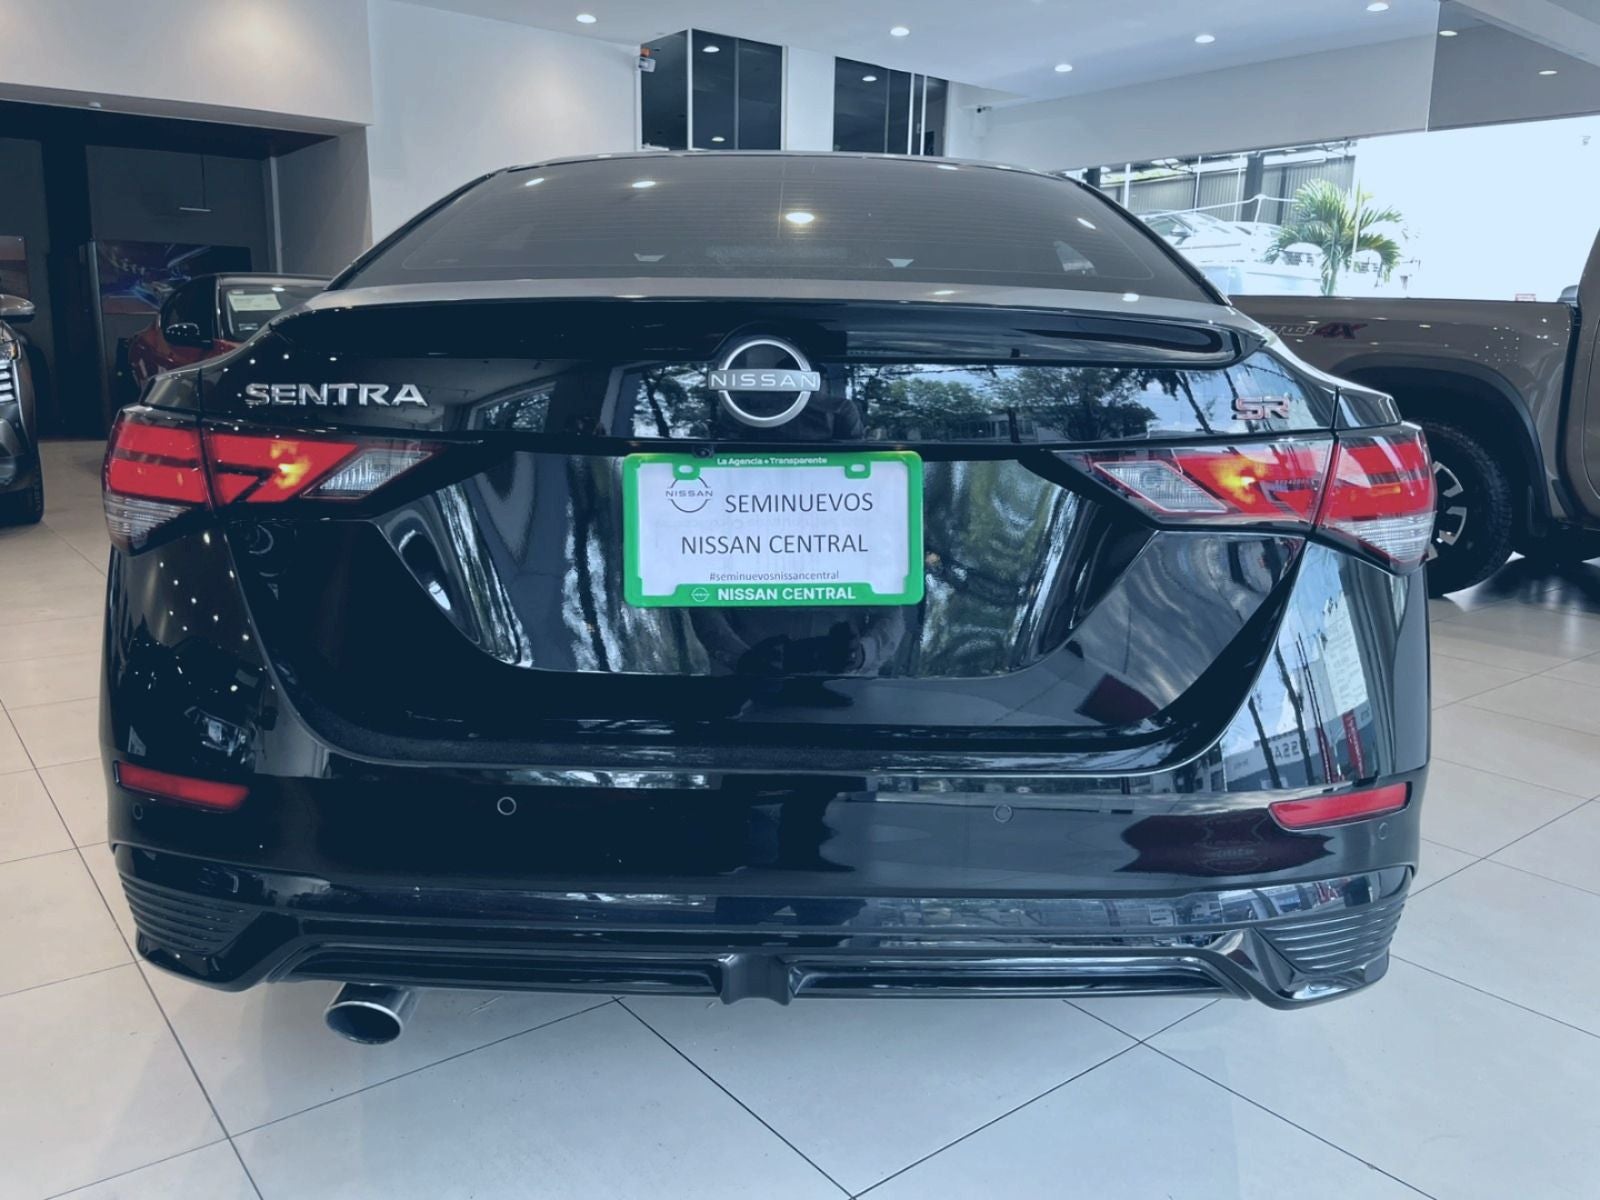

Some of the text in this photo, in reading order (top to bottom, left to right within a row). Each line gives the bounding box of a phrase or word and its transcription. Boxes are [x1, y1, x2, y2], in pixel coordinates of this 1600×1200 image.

[711, 373, 817, 388] NISSAN
[245, 383, 428, 406] SENTRA
[1231, 396, 1293, 420] SR
[717, 457, 728, 466] La
[728, 457, 763, 467] Agencia
[665, 490, 714, 498] NISSAN
[725, 492, 873, 513] SEMINUEVOS
[681, 534, 869, 555] NISSAN CENTRAL
[709, 569, 840, 581] #seminuevosnissancentral
[717, 588, 778, 601] NISSAN
[782, 586, 856, 601] CENTRAL
